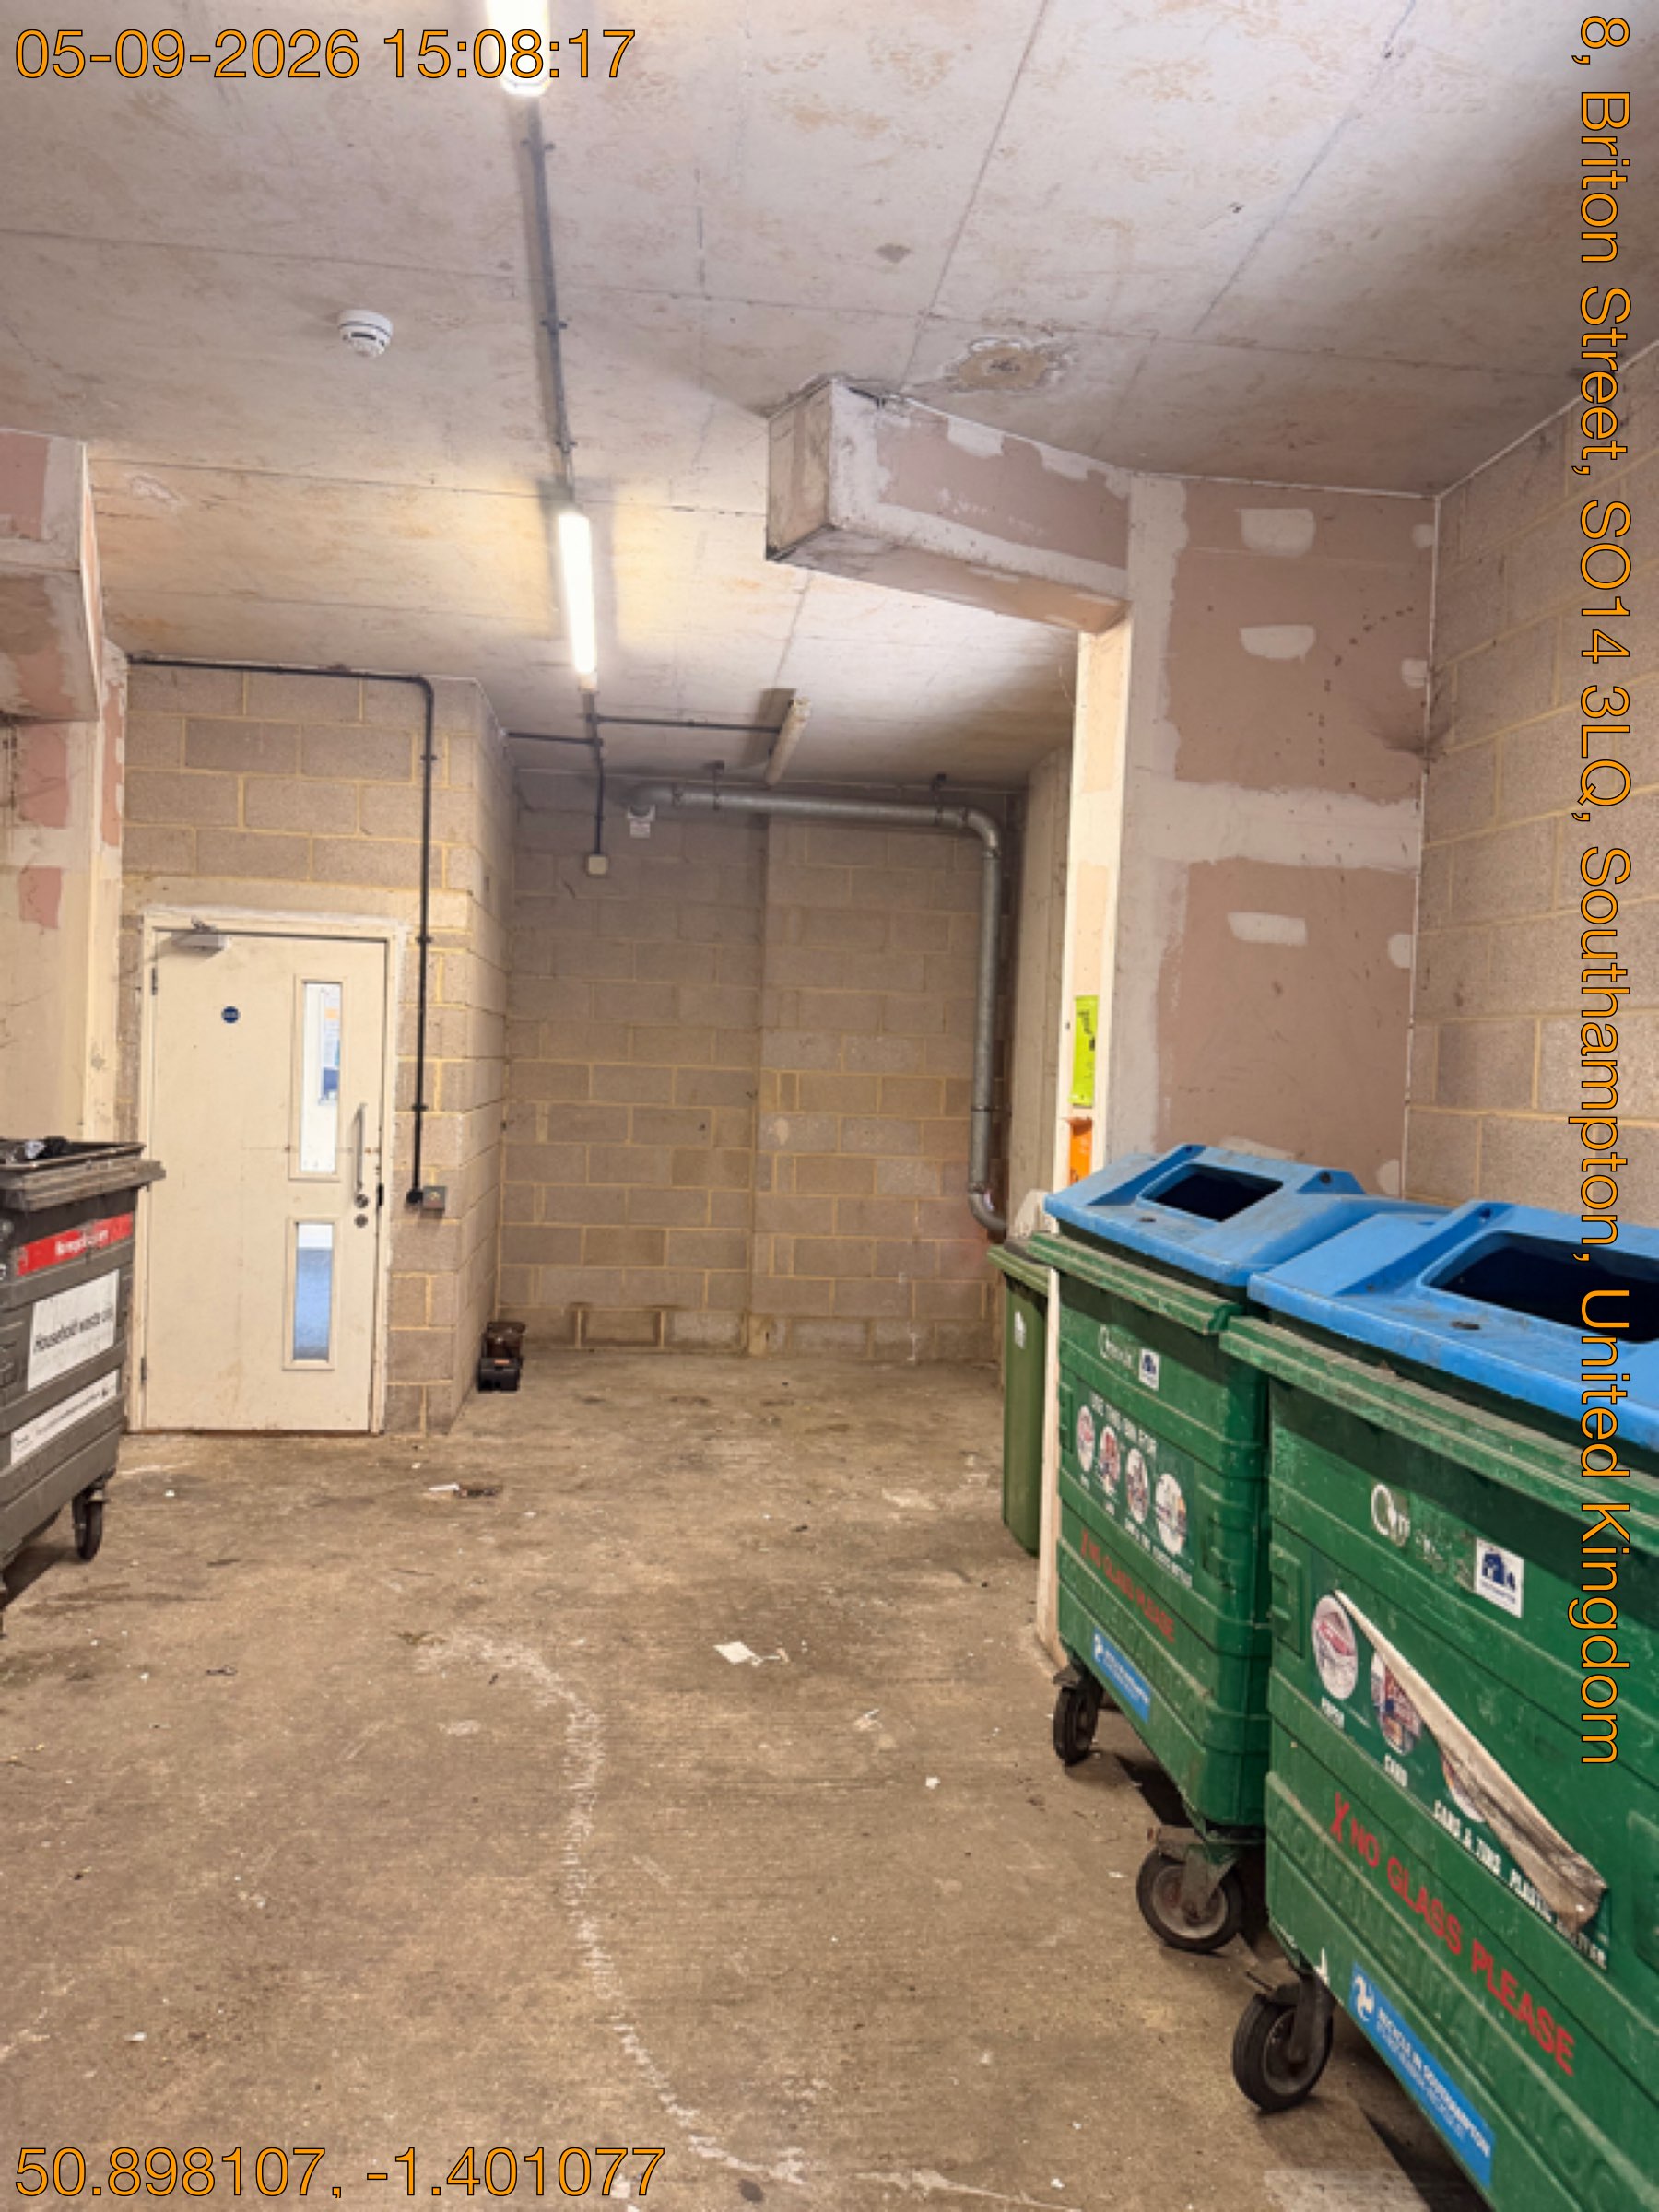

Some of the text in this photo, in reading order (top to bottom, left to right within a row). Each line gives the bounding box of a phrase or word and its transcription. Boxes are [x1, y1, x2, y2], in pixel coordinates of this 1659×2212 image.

[1350, 1818, 1380, 1867] NO
[1387, 1856, 1462, 1955] GLASS
[1471, 1938, 1575, 2076] PLEASE
